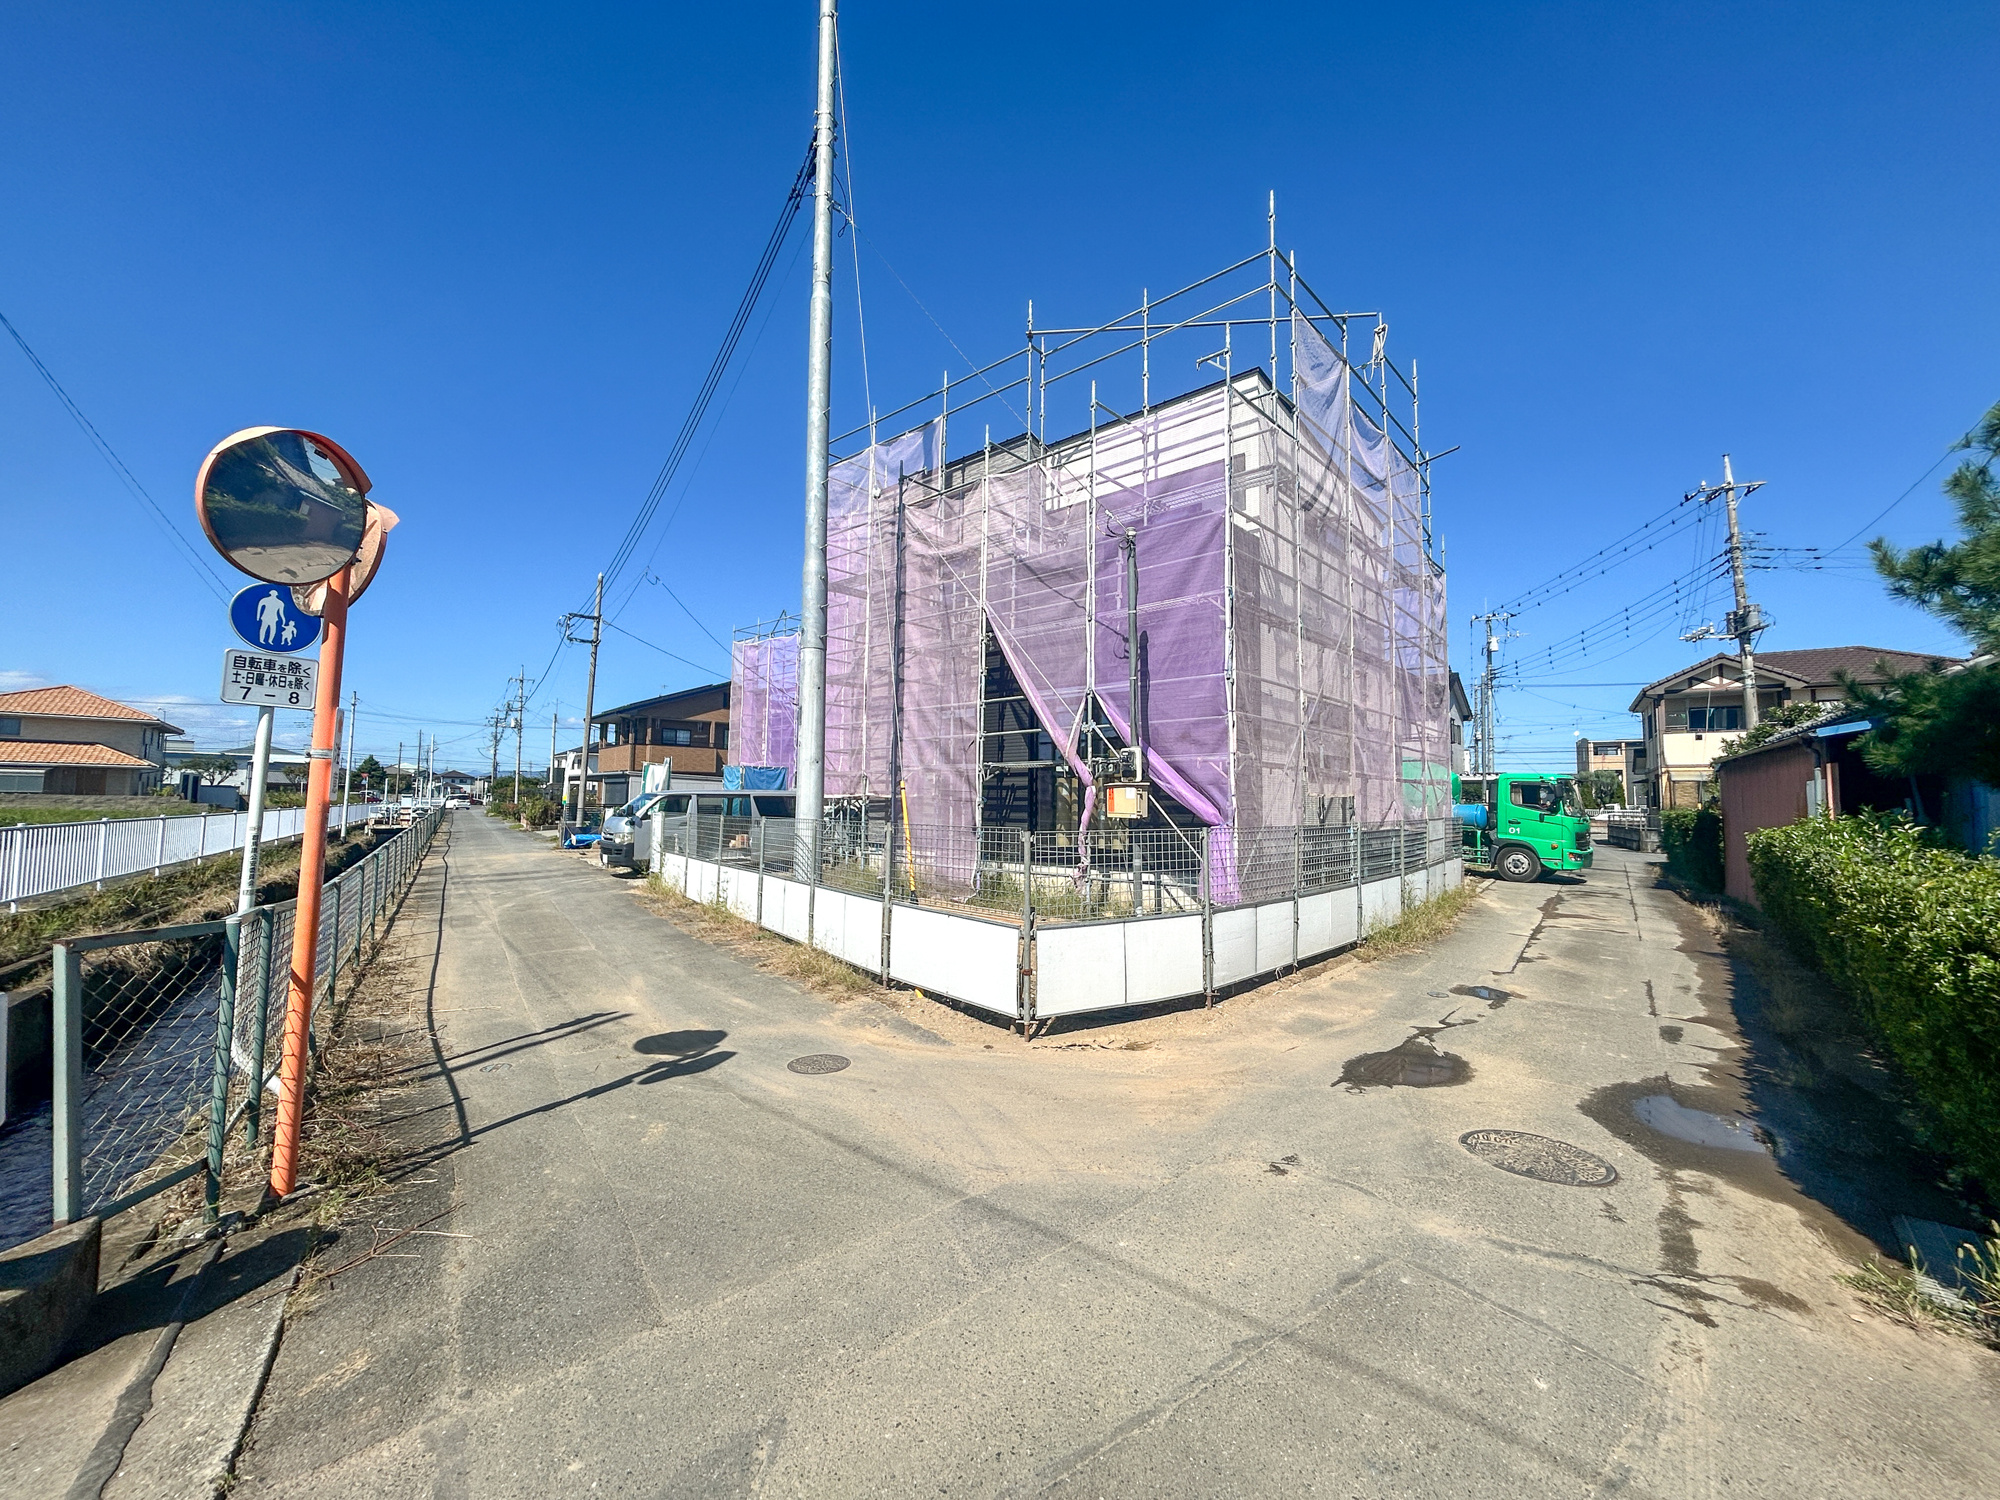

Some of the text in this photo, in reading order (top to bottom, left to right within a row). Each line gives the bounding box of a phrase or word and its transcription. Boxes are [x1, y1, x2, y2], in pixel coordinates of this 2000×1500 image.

[233, 655, 311, 676] 自転車を除く
